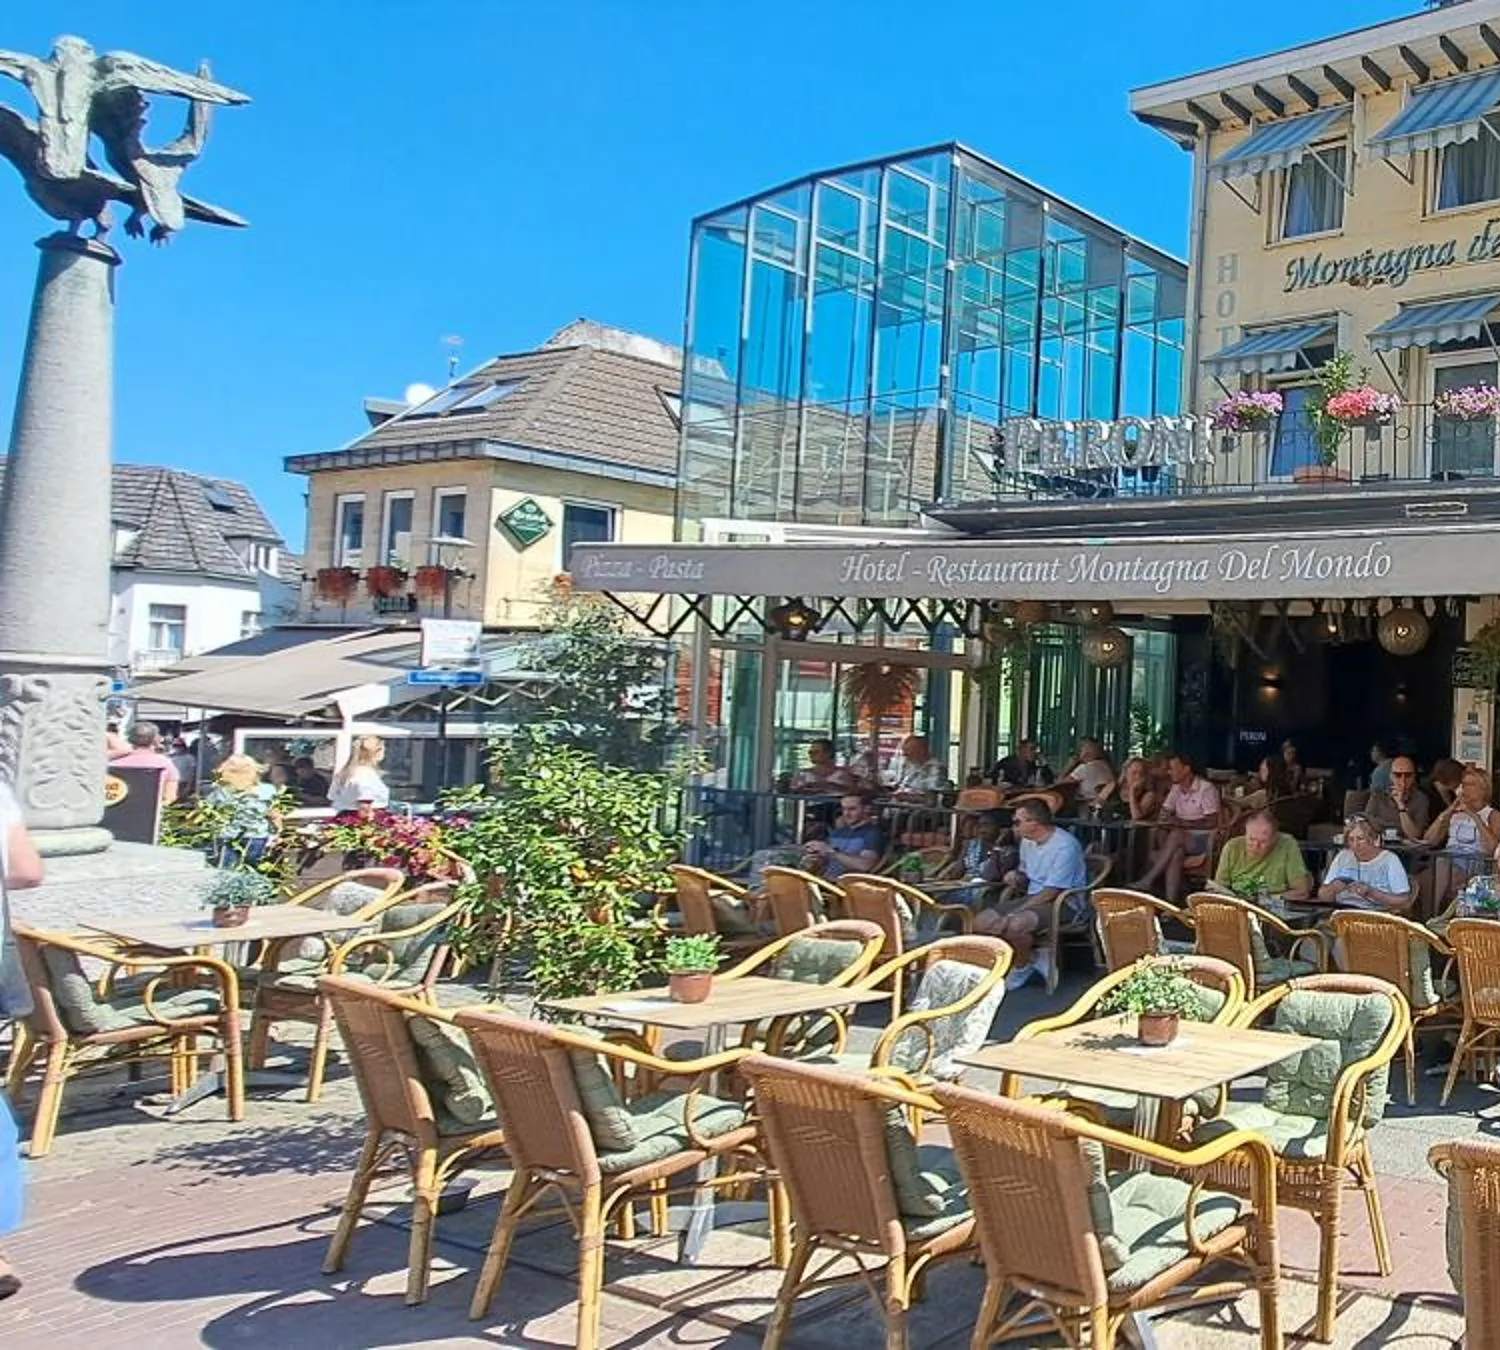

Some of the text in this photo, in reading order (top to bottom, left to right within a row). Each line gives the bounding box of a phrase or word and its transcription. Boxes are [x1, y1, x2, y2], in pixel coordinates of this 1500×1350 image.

[1282, 239, 1457, 293] Montagna
[1004, 413, 1215, 470] PERONI
[582, 555, 632, 578] Pizza
[650, 555, 705, 580] Pasta
[840, 551, 911, 583] Hotel
[927, 555, 1060, 587] Restaurant
[1067, 552, 1210, 593] Montagna
[1217, 545, 1279, 582] Del
[1279, 541, 1392, 582] Mondo
